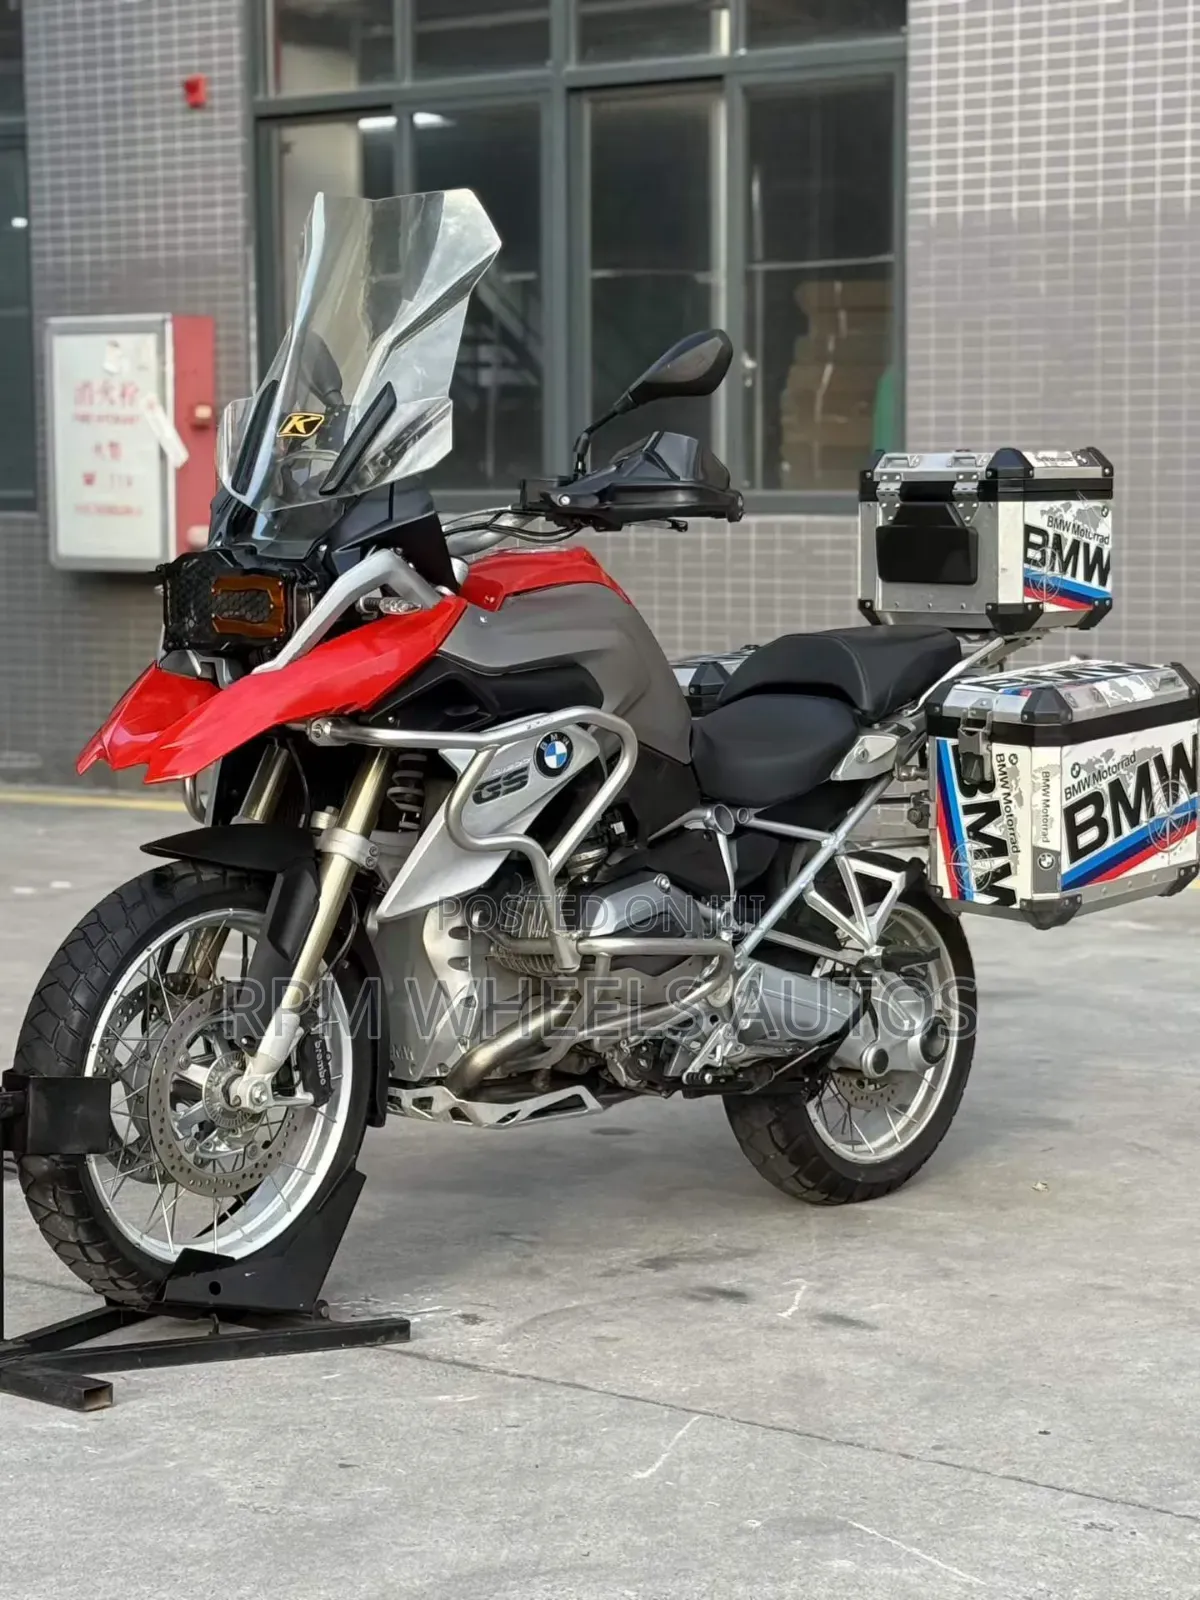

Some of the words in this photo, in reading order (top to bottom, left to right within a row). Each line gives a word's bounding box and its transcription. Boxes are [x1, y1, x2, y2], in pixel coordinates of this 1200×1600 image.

[1046, 515, 1072, 533] BMW
[1071, 522, 1110, 546] Motorrad
[1024, 524, 1111, 588] BMW
[472, 765, 530, 804] GS
[995, 753, 1010, 791] BMW
[1041, 771, 1051, 798] BMW
[1064, 777, 1092, 800] BMW
[1092, 749, 1137, 785] Motorrad
[1041, 799, 1051, 843] Motorrad
[1063, 733, 1198, 864] BMW
[1002, 792, 1021, 853] Motorrad
[314, 1039, 326, 1086] brembo
